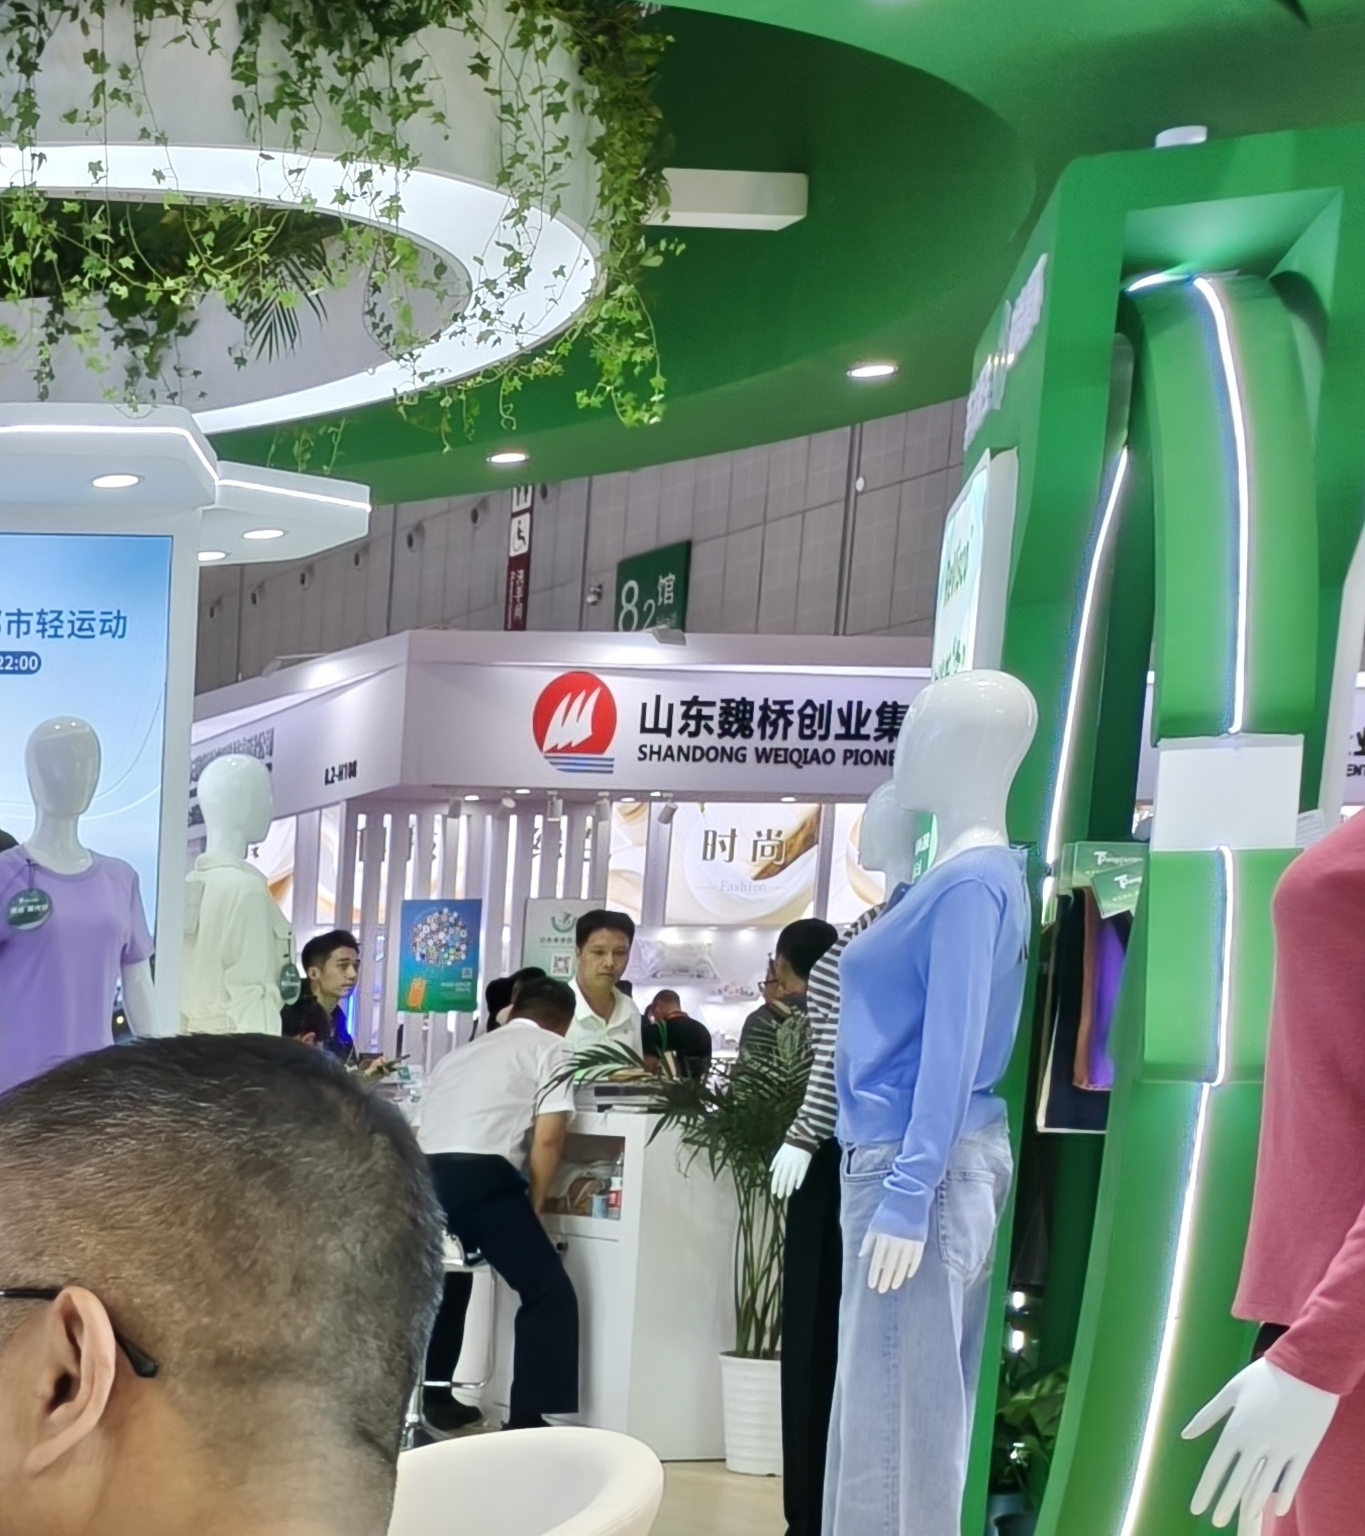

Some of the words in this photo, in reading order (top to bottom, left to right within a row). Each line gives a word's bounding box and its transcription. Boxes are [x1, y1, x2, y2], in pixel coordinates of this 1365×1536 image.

[639, 695, 910, 743] 山东魏桥创业集
[638, 744, 747, 764] SHANDONG
[754, 746, 836, 768] WEIQIAO
[702, 828, 786, 865] 时尚
[720, 880, 767, 892] Fashion
